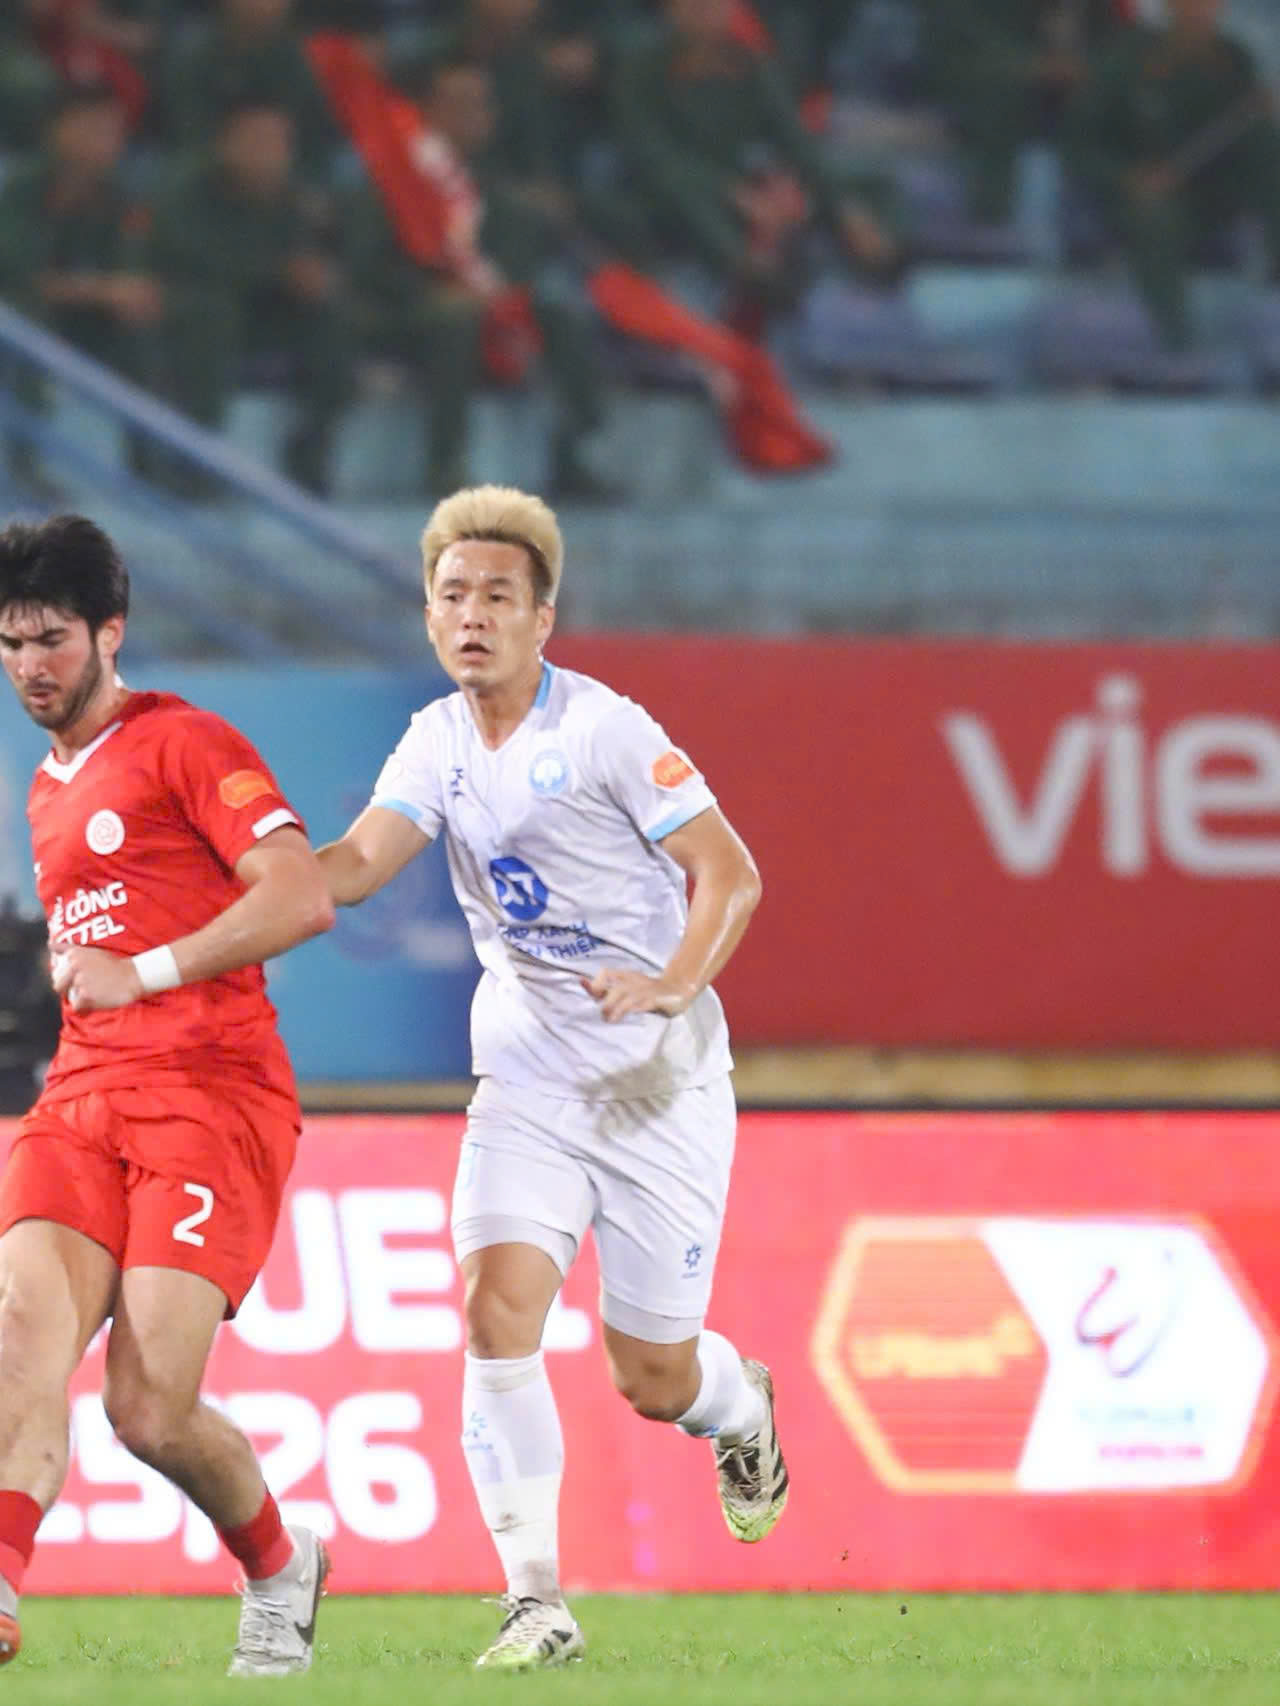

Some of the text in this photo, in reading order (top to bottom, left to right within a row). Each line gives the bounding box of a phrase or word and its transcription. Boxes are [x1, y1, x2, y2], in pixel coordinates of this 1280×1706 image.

[940, 674, 1280, 877] vie
[65, 881, 129, 924] CÔNG
[172, 1181, 215, 1249] 2
